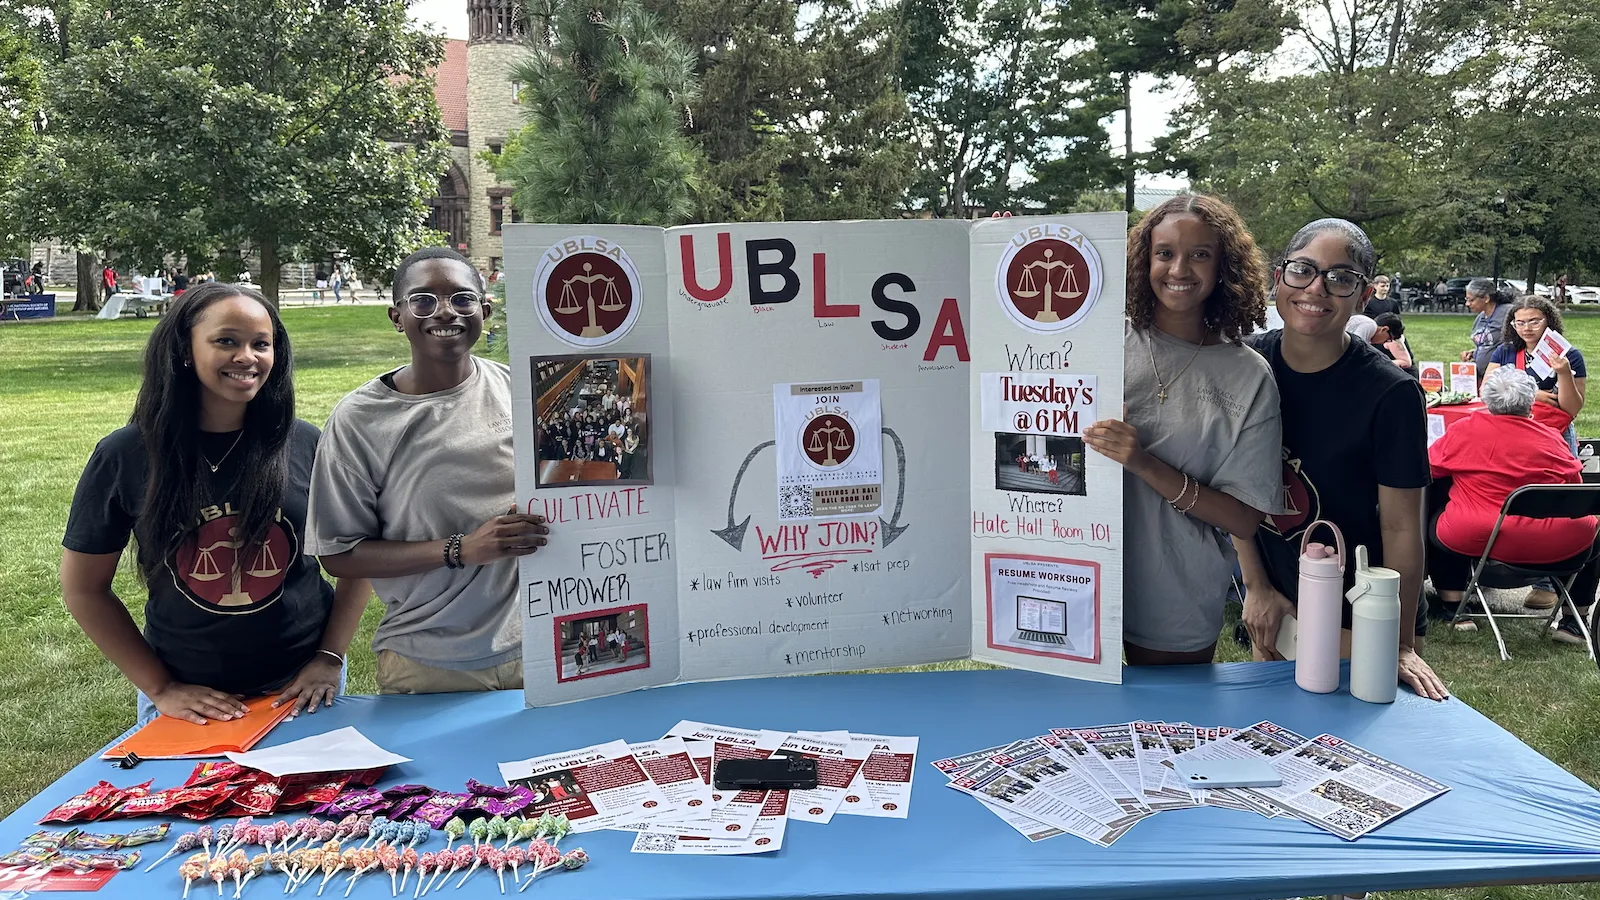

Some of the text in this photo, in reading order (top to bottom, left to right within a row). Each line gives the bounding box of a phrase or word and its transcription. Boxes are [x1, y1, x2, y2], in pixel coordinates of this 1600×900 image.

[1012, 224, 1085, 248] UBLSA
[547, 238, 623, 263] UBLSA
[818, 319, 835, 328] Law
[1005, 340, 1073, 371] When?
[815, 396, 840, 404] JOIN
[1000, 376, 1093, 411] Tuesday's
[1197, 387, 1246, 412] LAW STUDENTS
[1214, 386, 1236, 400] BLACK
[804, 406, 850, 421] UBLSA
[1013, 409, 1079, 433] @ 6 PM
[815, 489, 848, 497] MEETINGS
[840, 495, 859, 503] ROOM
[527, 487, 650, 525] CULTIVATE
[1007, 493, 1063, 513] Where?
[1017, 515, 1042, 536] Hall
[1052, 518, 1084, 540] Room
[1091, 523, 1111, 542] 101
[755, 521, 879, 555] WHY JOIN?
[581, 532, 671, 571] FOSTER
[887, 558, 910, 572] prep
[727, 571, 749, 588] firm
[753, 573, 781, 587] visits
[998, 568, 1091, 585] RESUME WORKSHOP
[528, 573, 631, 618] EMPOWER
[769, 618, 829, 638] development
[692, 731, 756, 746] Join UBLSA
[706, 727, 737, 735] Interested
[801, 744, 844, 756] UBLSA
[955, 750, 995, 763] PRE-LAW
[531, 764, 557, 774] Join
[559, 754, 606, 768] UBLSA
[535, 755, 571, 765] Interested
